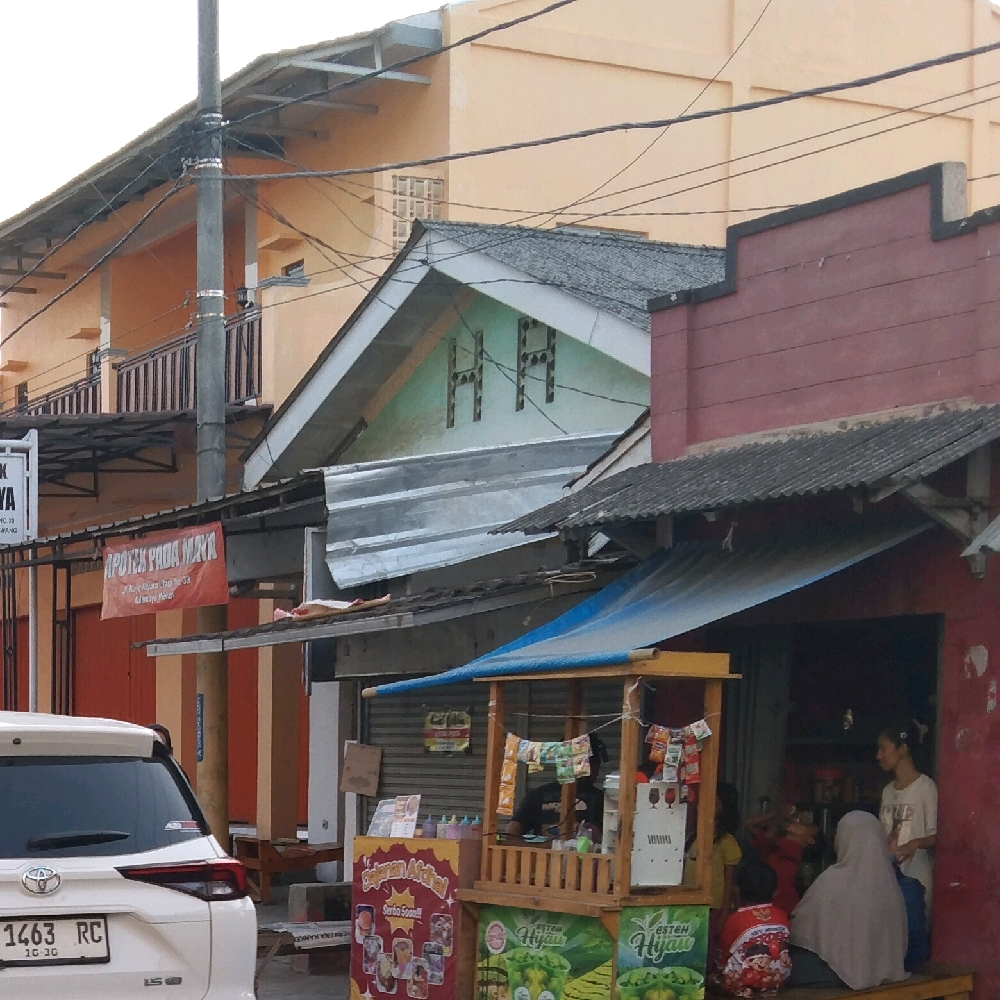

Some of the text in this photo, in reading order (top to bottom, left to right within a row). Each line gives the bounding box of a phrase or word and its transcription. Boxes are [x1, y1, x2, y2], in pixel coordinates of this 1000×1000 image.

[105, 531, 217, 578] APOTEK PADA MAYA
[3, 922, 55, 947] 1463
[76, 921, 103, 944] RC
[631, 931, 692, 962] Hijau
